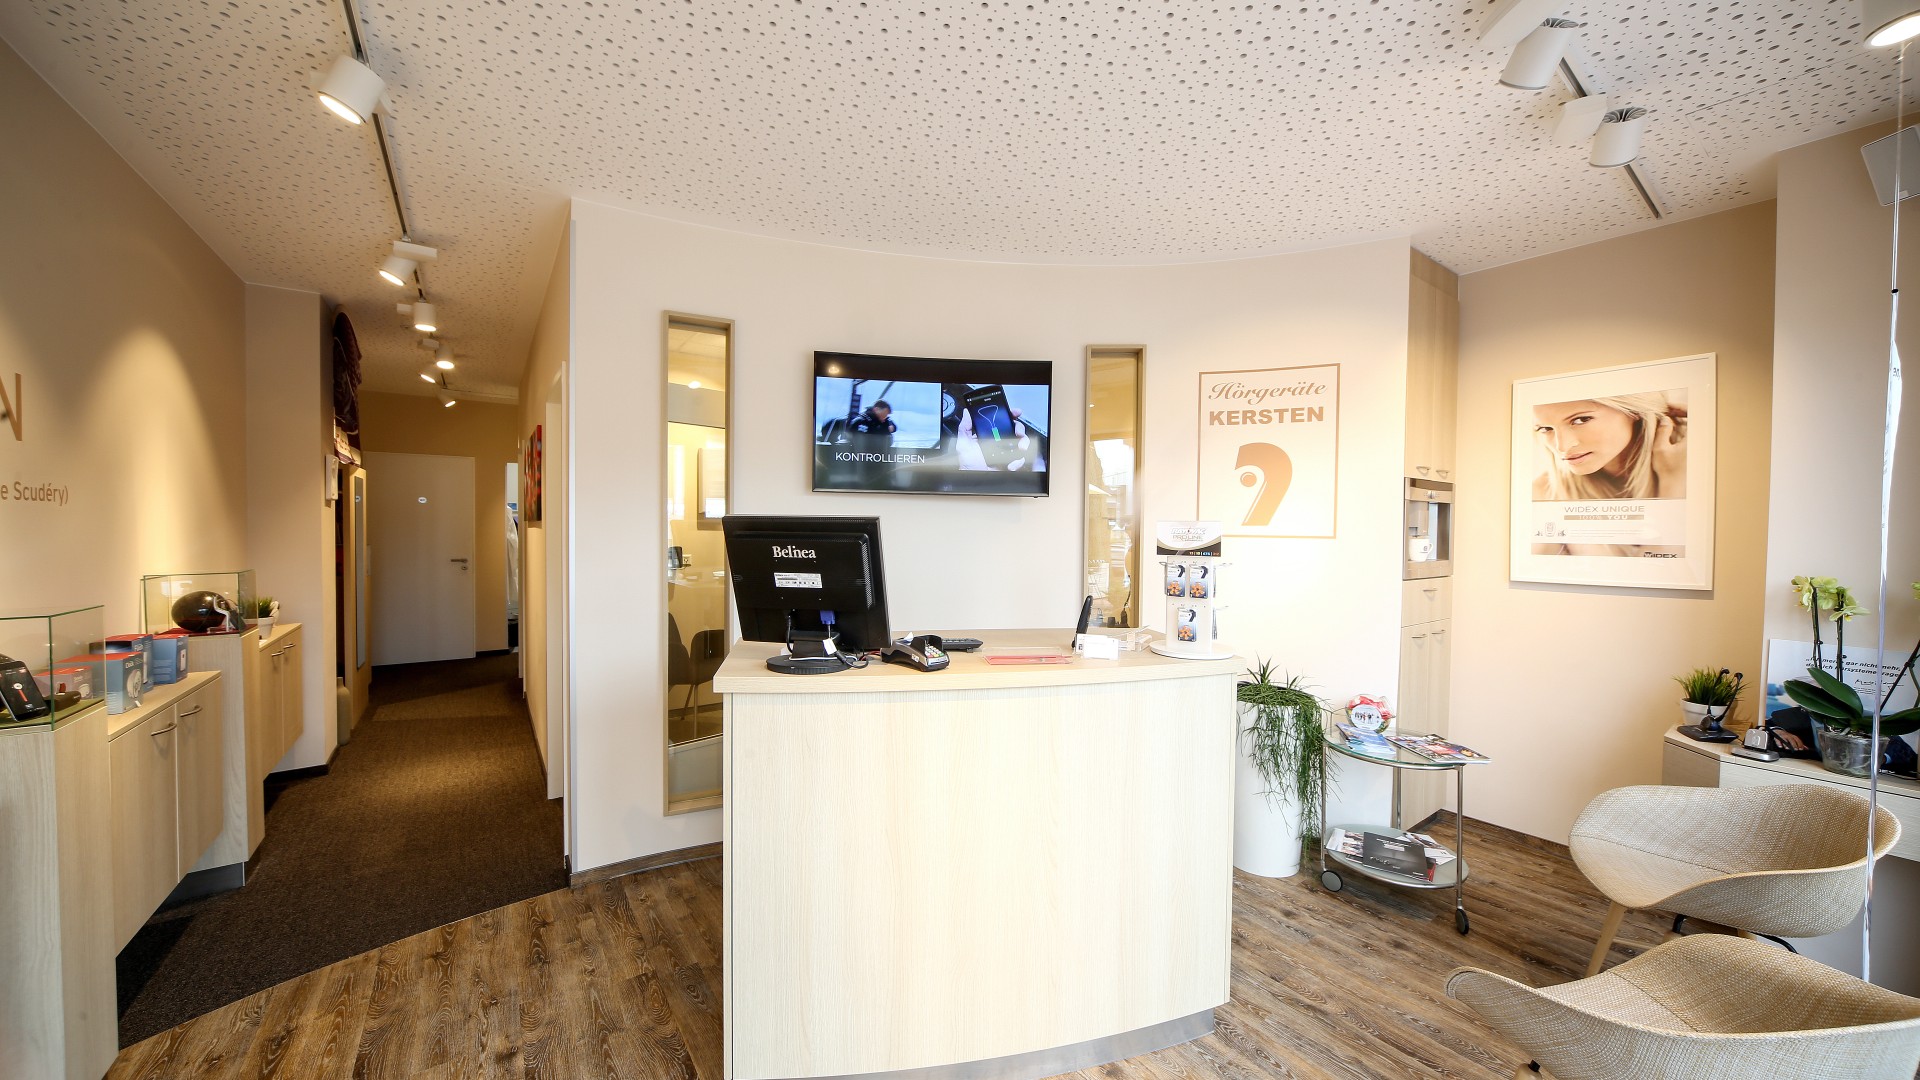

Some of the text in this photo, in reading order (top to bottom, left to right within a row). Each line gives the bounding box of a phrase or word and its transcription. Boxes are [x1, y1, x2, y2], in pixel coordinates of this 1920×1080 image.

[1208, 382, 1327, 405] Hörgeräte
[1209, 406, 1324, 426] KERSTEN
[835, 452, 925, 464] KONTROLLIEREN
[13, 481, 69, 506] Scudéry)
[1601, 505, 1645, 513] UNIQUE
[772, 545, 817, 559] Belinea
[1643, 551, 1678, 559] WIDEX
